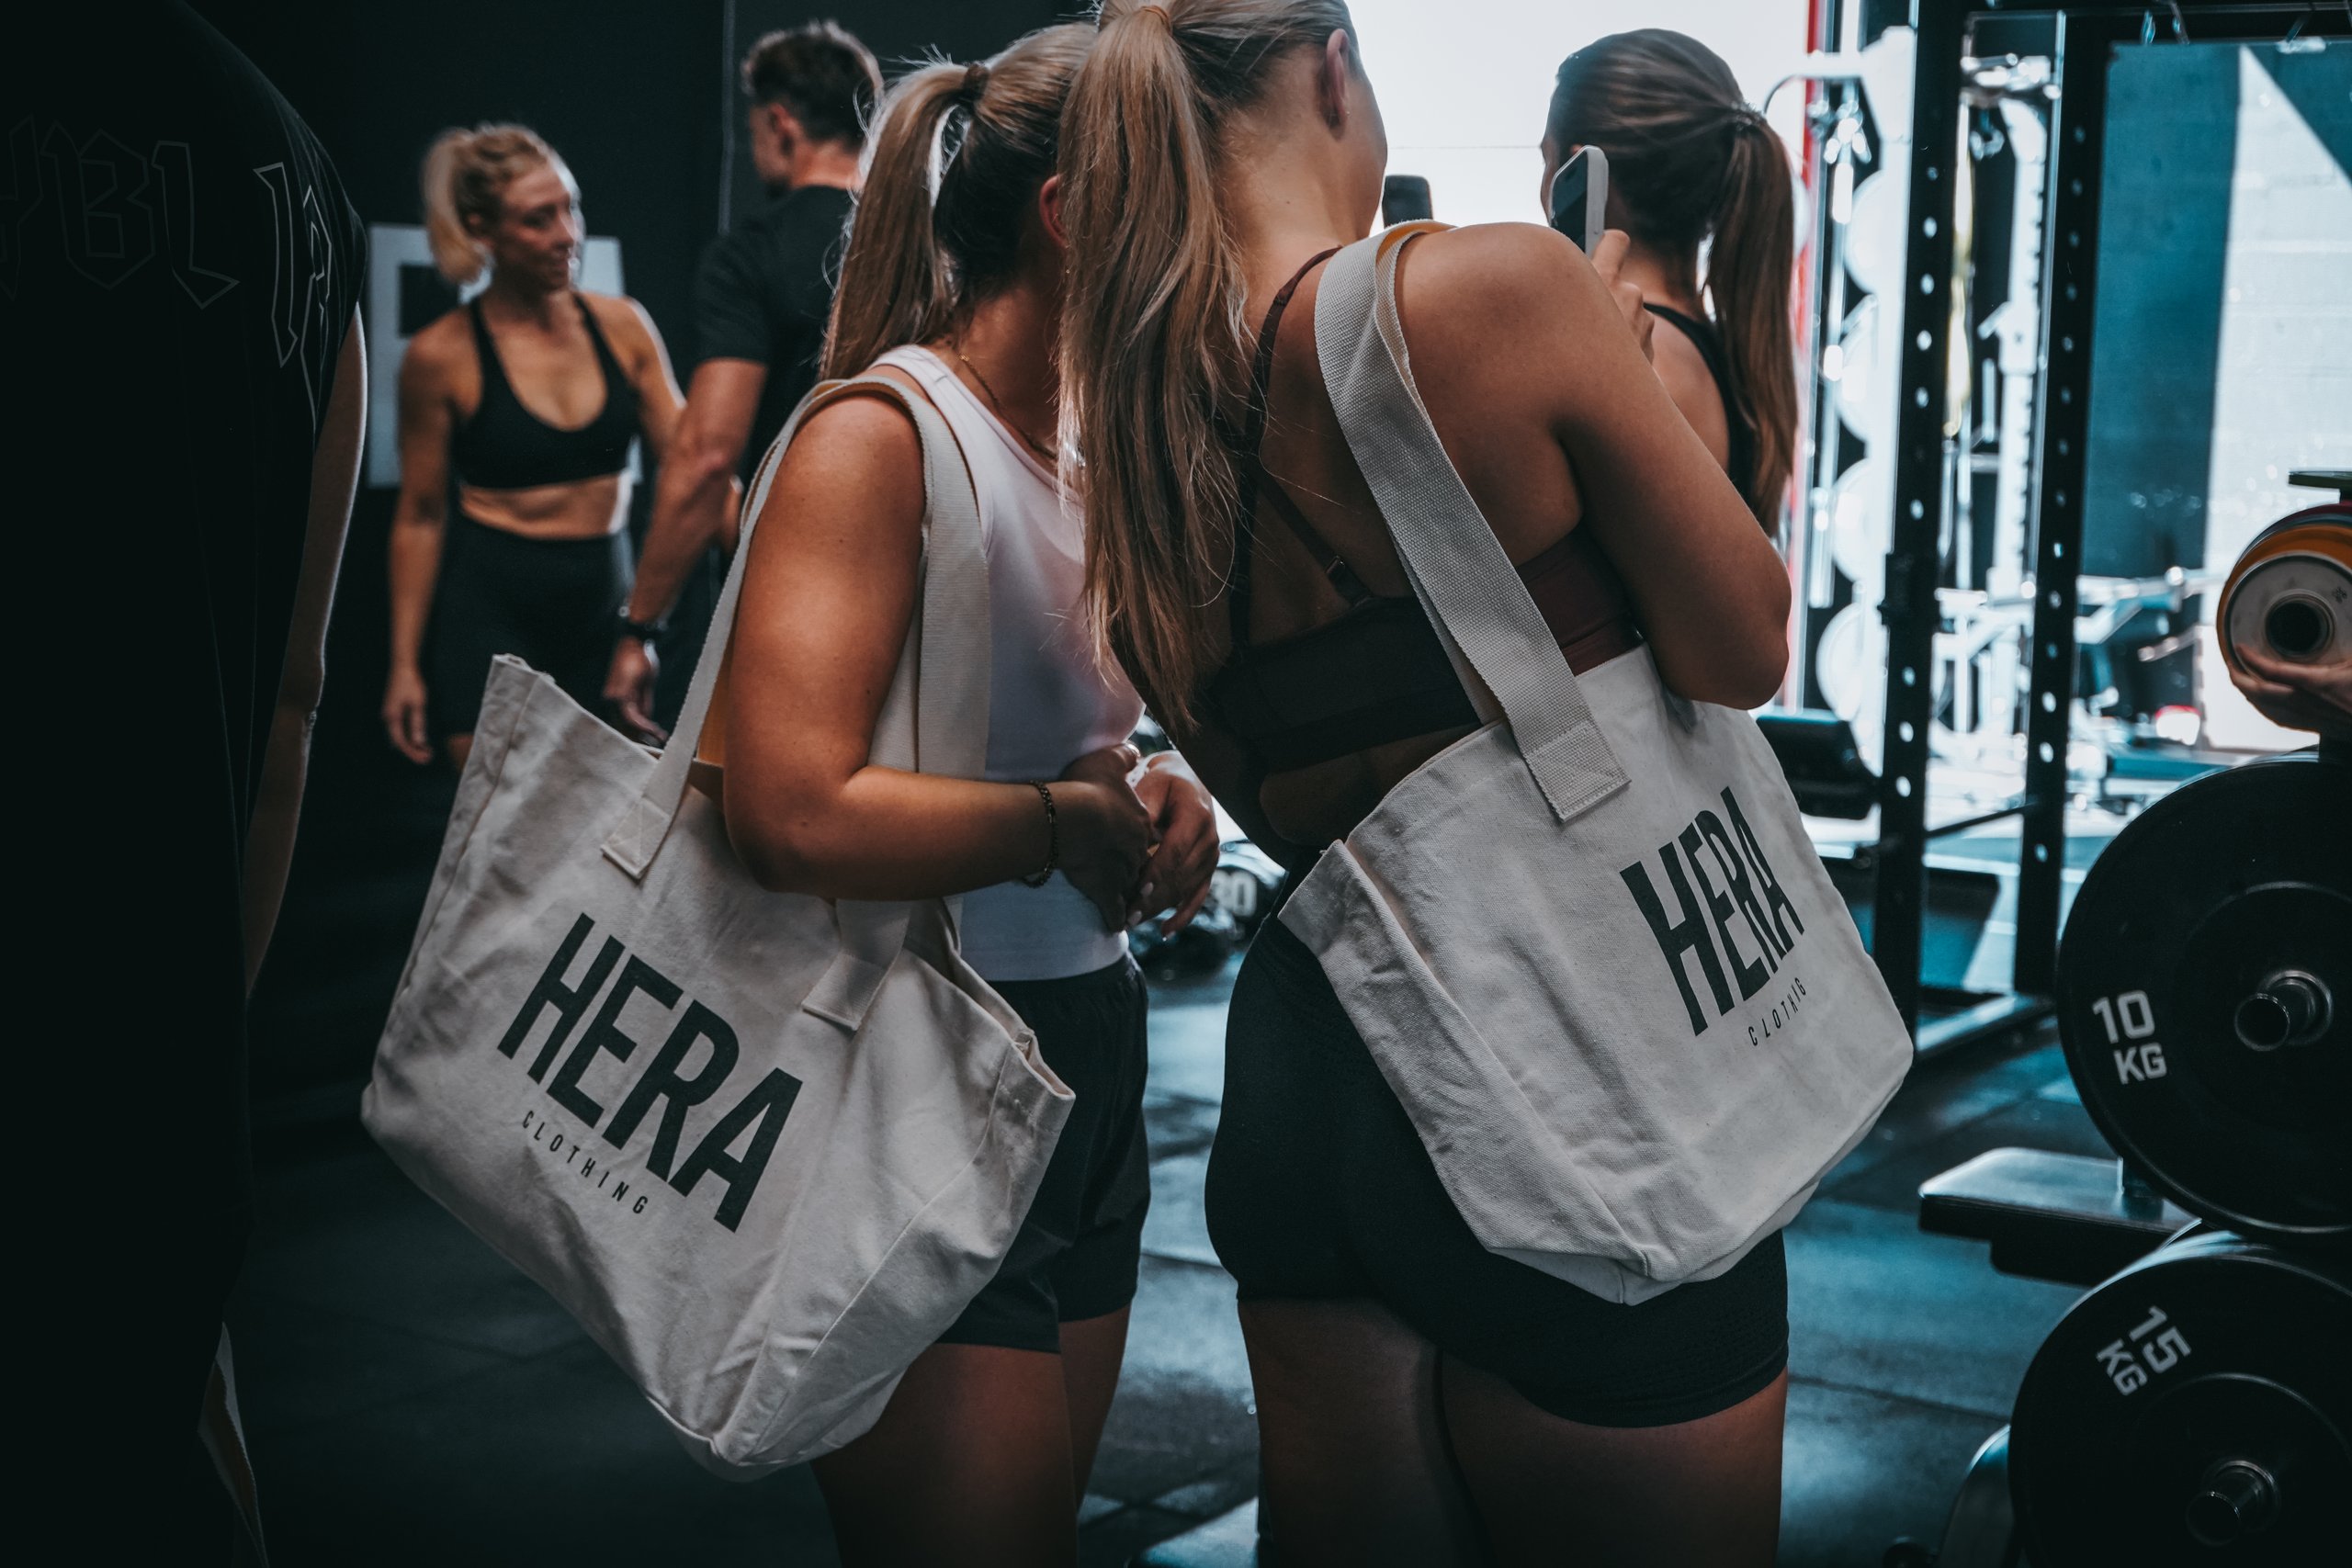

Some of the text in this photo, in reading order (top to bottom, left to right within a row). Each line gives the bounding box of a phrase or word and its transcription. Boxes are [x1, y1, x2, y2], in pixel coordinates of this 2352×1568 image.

[1619, 786, 1804, 1036] HERA
[2092, 989, 2156, 1044] 10
[497, 912, 803, 1233] HERA
[2114, 1043, 2168, 1086] KG
[522, 1111, 648, 1214] CLOTHING
[2096, 1338, 2149, 1397] KG
[2128, 1304, 2192, 1374] 15
